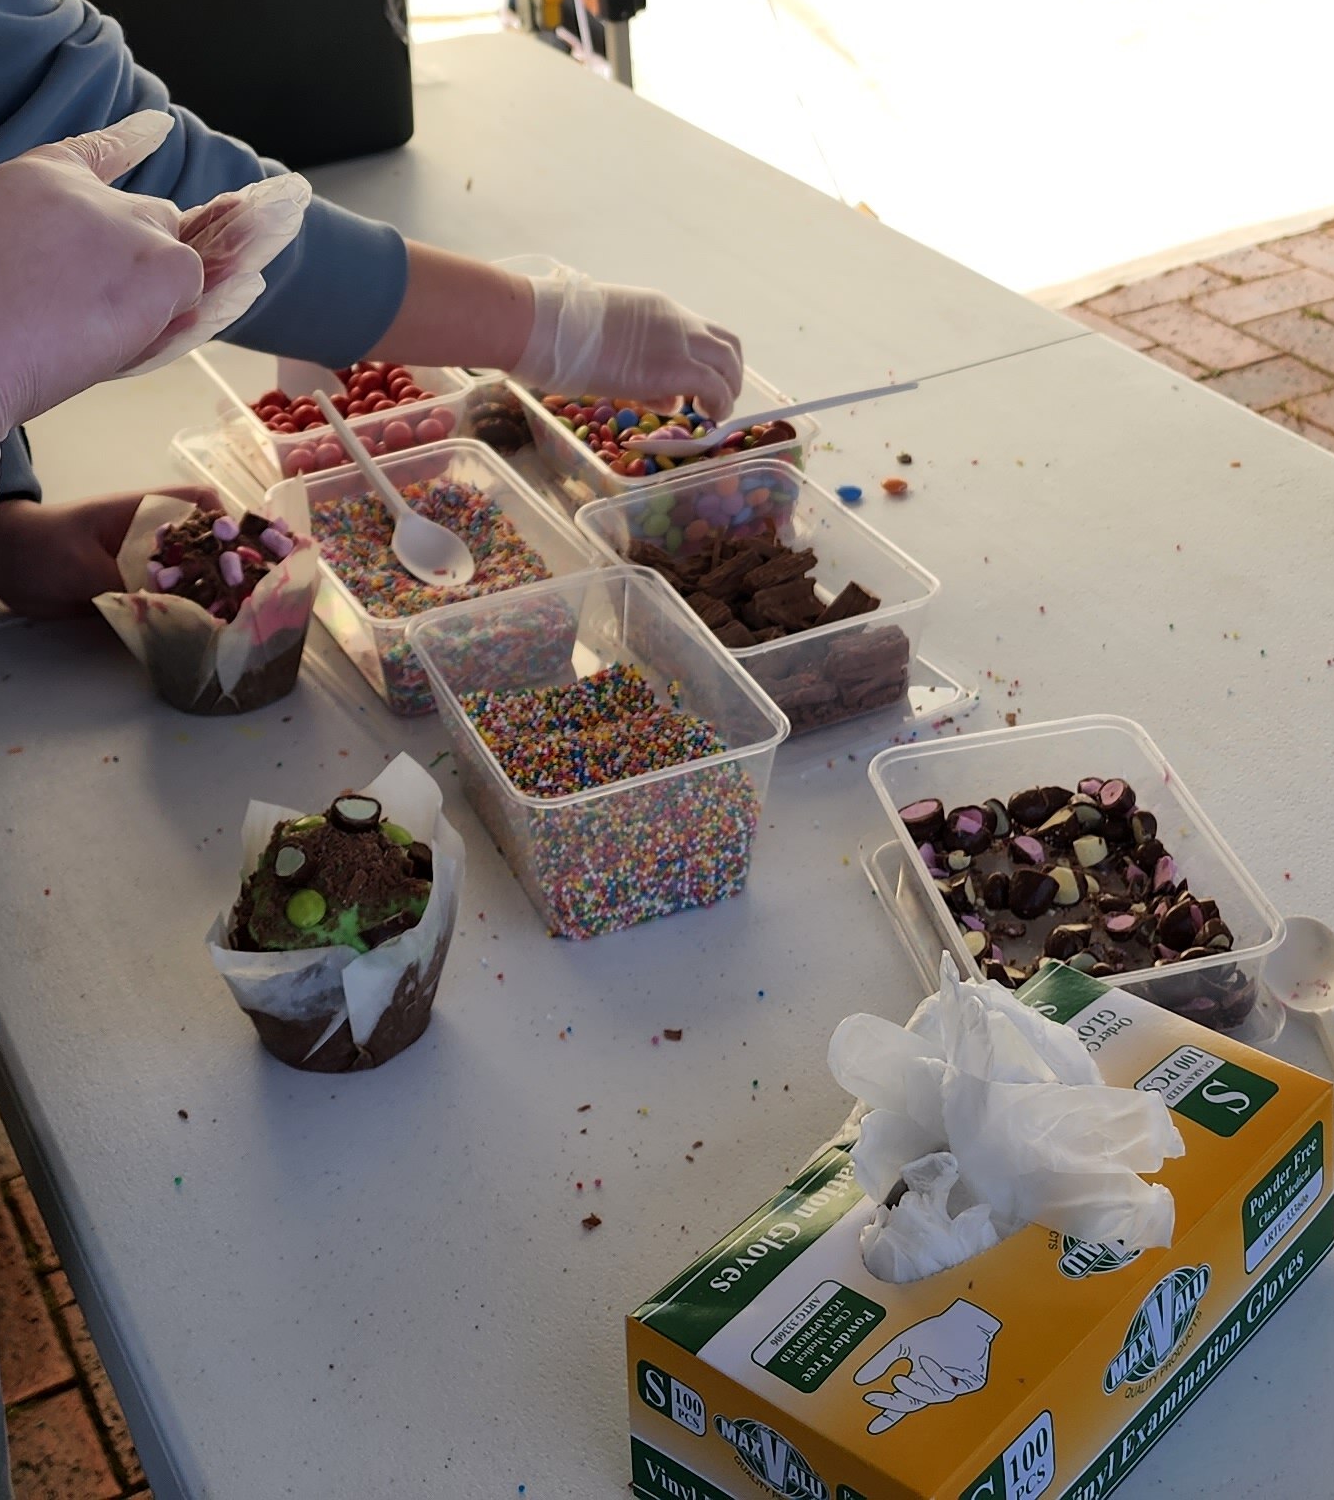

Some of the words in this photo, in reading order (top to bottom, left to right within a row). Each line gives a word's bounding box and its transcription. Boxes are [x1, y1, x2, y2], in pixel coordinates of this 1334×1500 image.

[1098, 1017, 1133, 1042] Order
[1172, 1049, 1204, 1071] 100
[1143, 1068, 1182, 1093] PCS
[1166, 1060, 1216, 1102] GUARANTEED
[1201, 1078, 1251, 1116] S
[1249, 1164, 1292, 1218] Powder
[1294, 1137, 1318, 1171] Free
[1258, 1204, 1278, 1229] Class
[1284, 1164, 1312, 1203] Medical
[709, 1221, 802, 1294] Gloves
[795, 1296, 821, 1323] ARTG
[823, 1299, 846, 1318] TGA
[828, 1309, 853, 1329] Class
[780, 1319, 824, 1364] APPROVED
[794, 1333, 828, 1367] Medical
[830, 1309, 877, 1355] Powder
[801, 1352, 834, 1383] Free
[1120, 1321, 1242, 1466] Examination
[1246, 1249, 1305, 1324] Gloves
[644, 1368, 666, 1408] S
[673, 1388, 702, 1417] 100
[1124, 1372, 1160, 1399] QUALITY
[677, 1409, 700, 1430] PCS
[1009, 1427, 1048, 1486] 100
[644, 1457, 697, 1500] Vinyl
[1016, 1463, 1046, 1500] PCS
